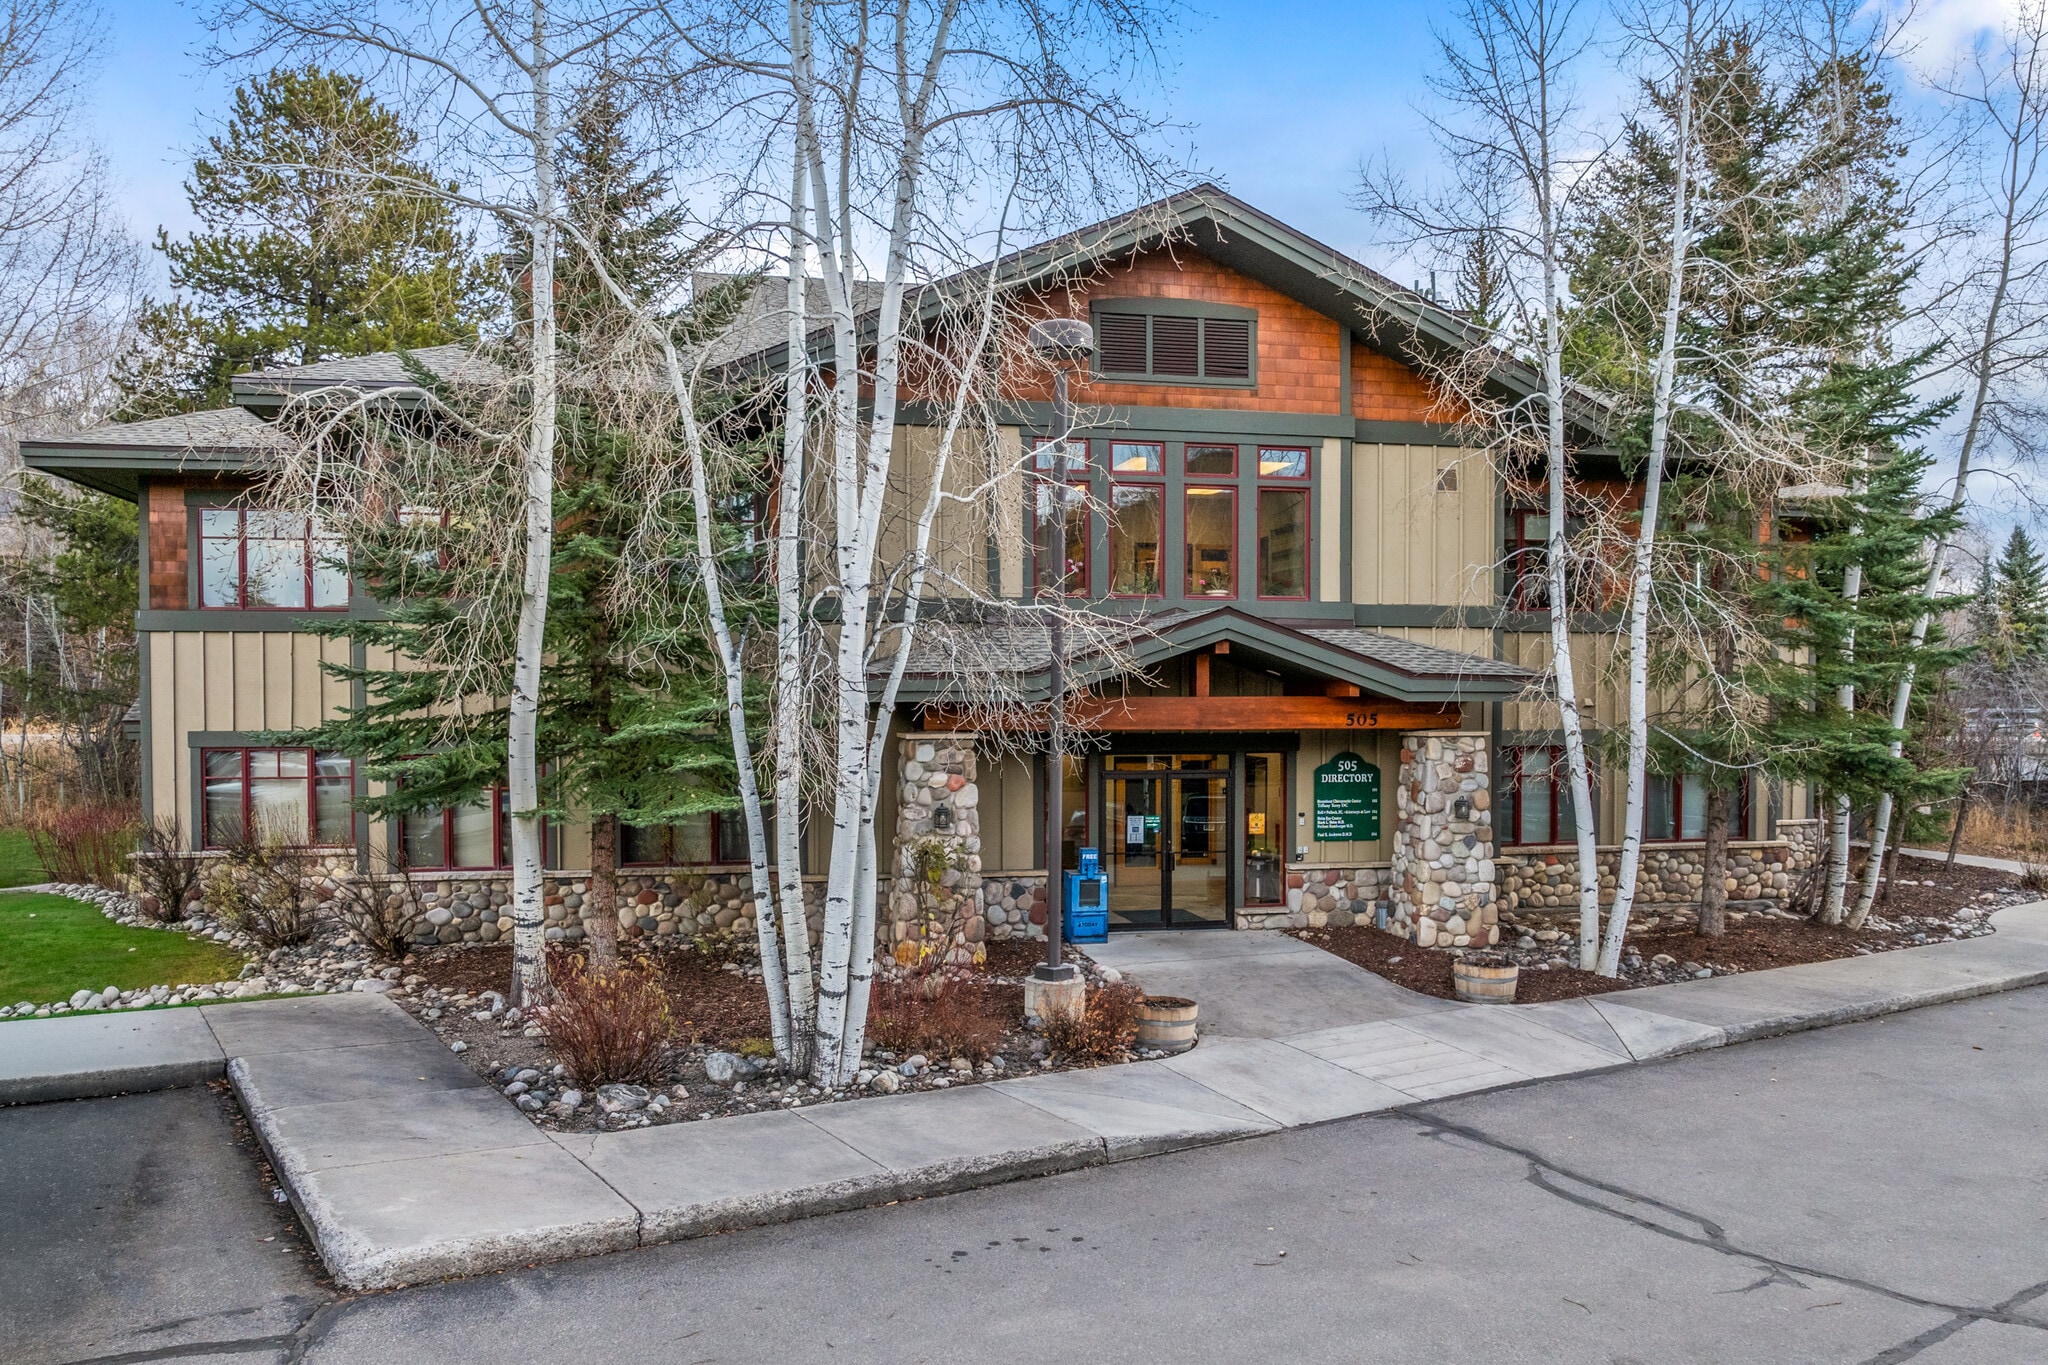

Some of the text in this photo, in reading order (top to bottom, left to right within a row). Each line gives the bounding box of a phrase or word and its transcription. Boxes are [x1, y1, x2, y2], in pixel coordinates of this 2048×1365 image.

[1345, 712, 1378, 727] 505
[1337, 760, 1358, 772] 505
[1321, 773, 1374, 783] DIRECTORY
